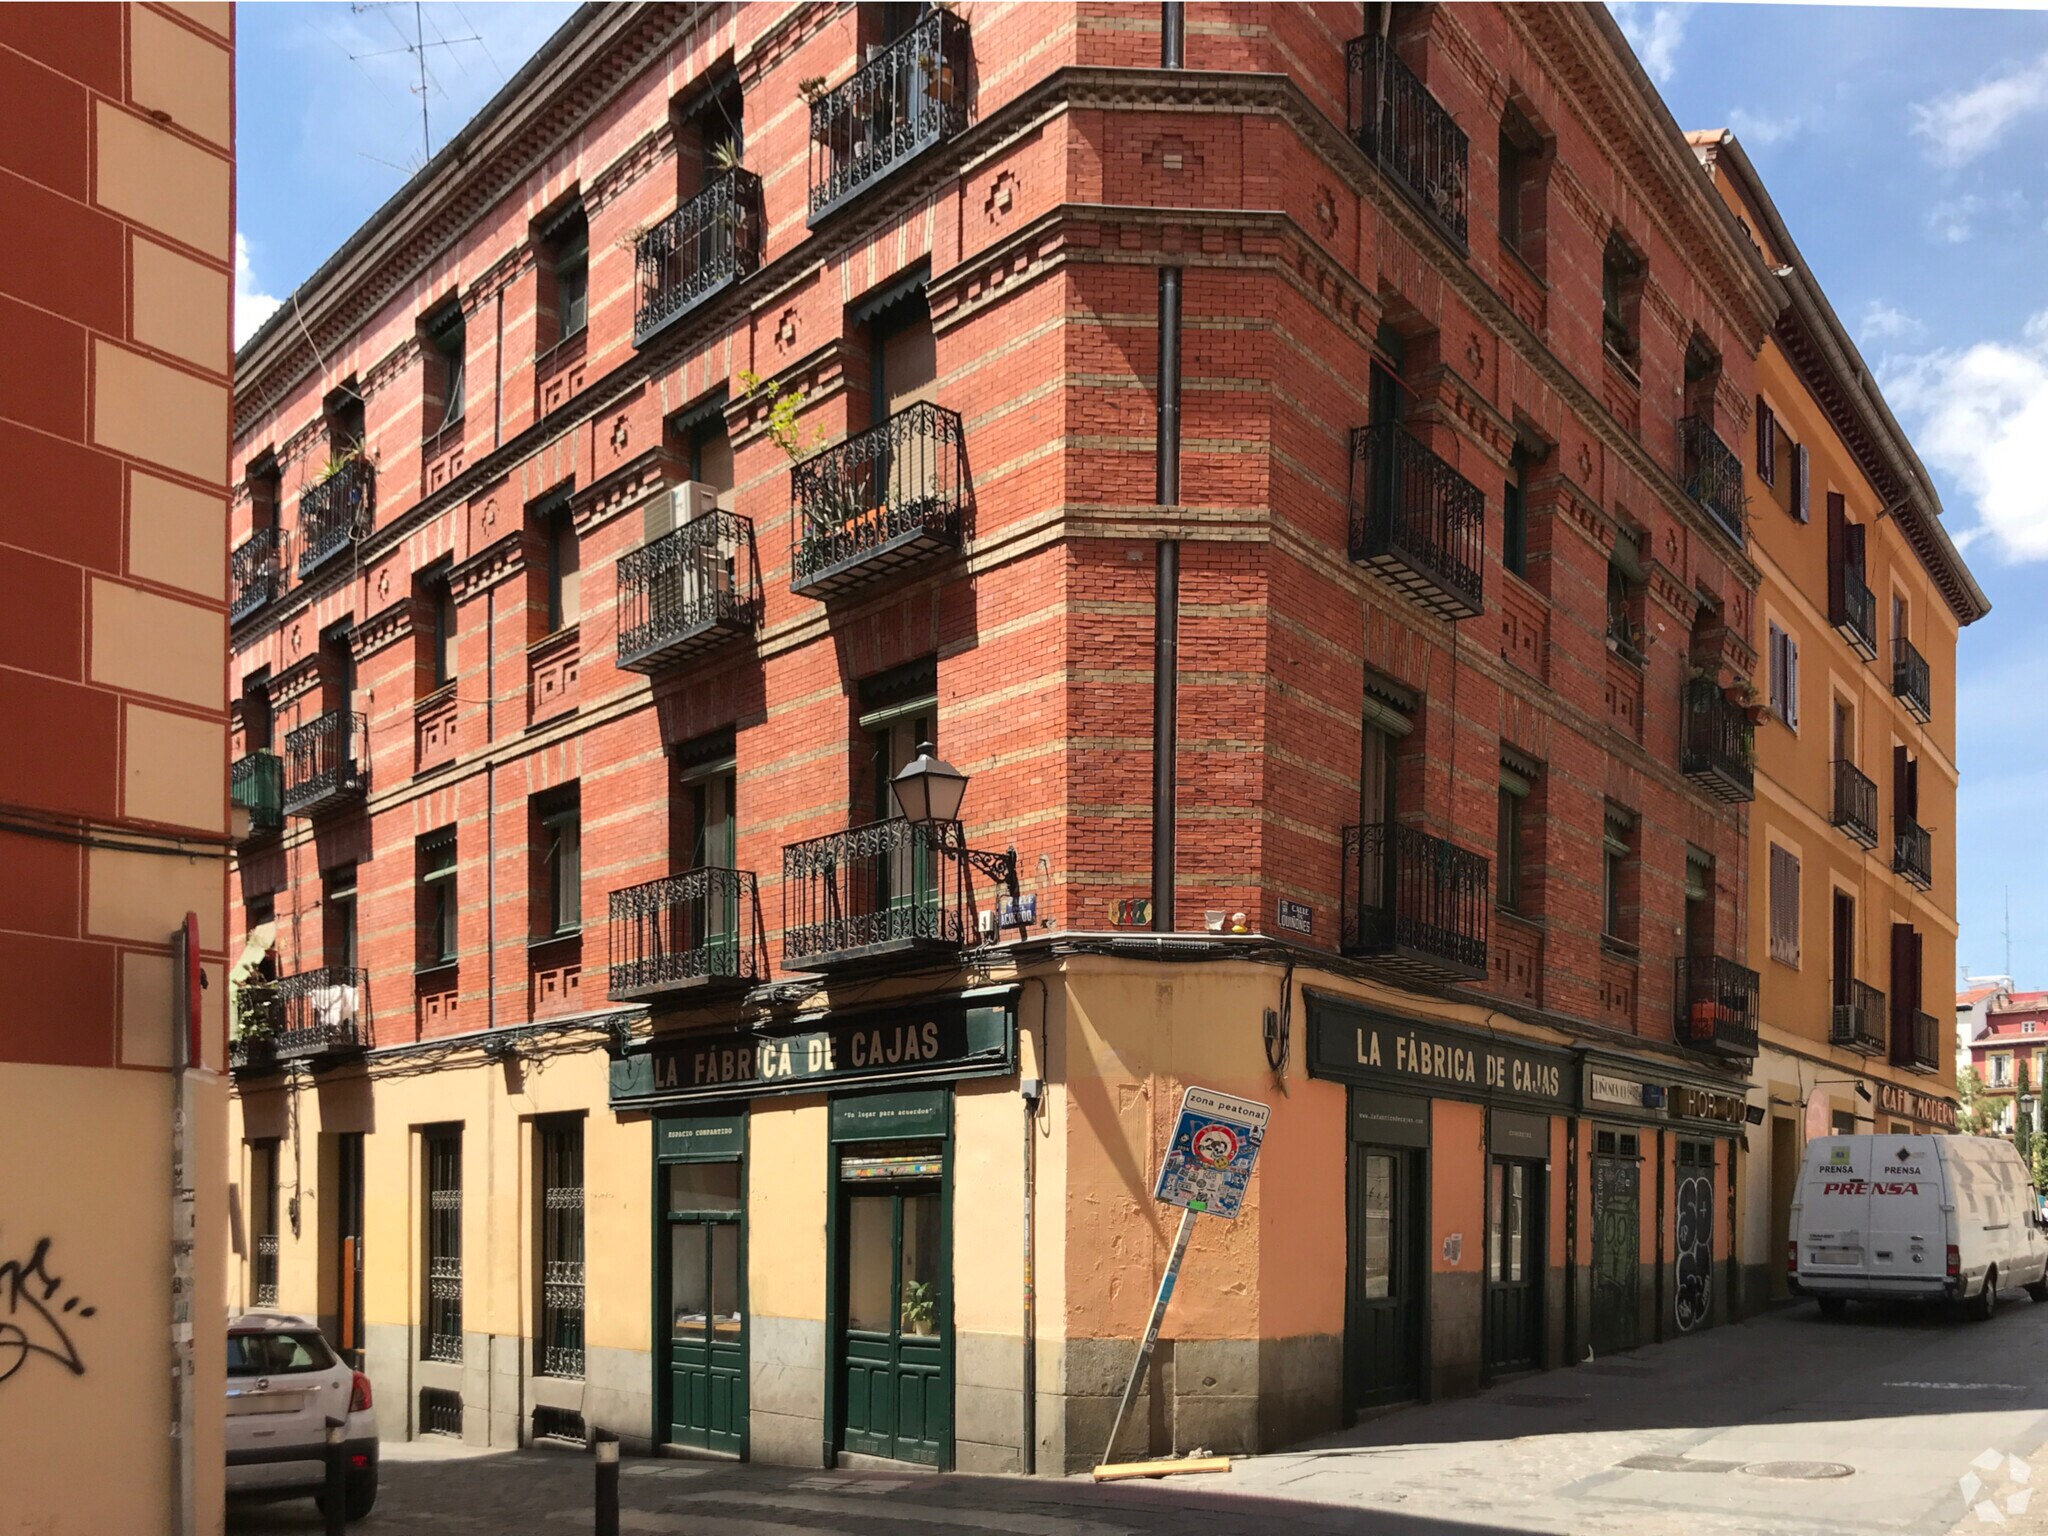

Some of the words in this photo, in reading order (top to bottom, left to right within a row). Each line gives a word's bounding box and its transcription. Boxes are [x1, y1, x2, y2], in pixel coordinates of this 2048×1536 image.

[1291, 904, 1309, 915] CALLE
[655, 1057, 678, 1088] LA
[694, 1043, 792, 1084] FÁBRICA
[808, 1037, 837, 1073] DE
[851, 1021, 938, 1068] CAJAS
[1357, 1028, 1381, 1067] LA
[1396, 1031, 1476, 1083] FÁBRICA
[1486, 1054, 1505, 1088] DE
[1513, 1058, 1559, 1097] CAJAS
[1190, 1095, 1214, 1107] zona
[1218, 1102, 1265, 1120] peatonal
[1688, 1089, 1747, 1124] HORCIO
[879, 1110, 895, 1118] para
[668, 1130, 693, 1138] ESPACIO
[695, 1127, 733, 1137] COMPARTIDO
[1819, 1165, 1854, 1174] PRENSA
[1884, 1166, 1921, 1175] PRENSA
[1823, 1182, 1919, 1196] PRENSA
